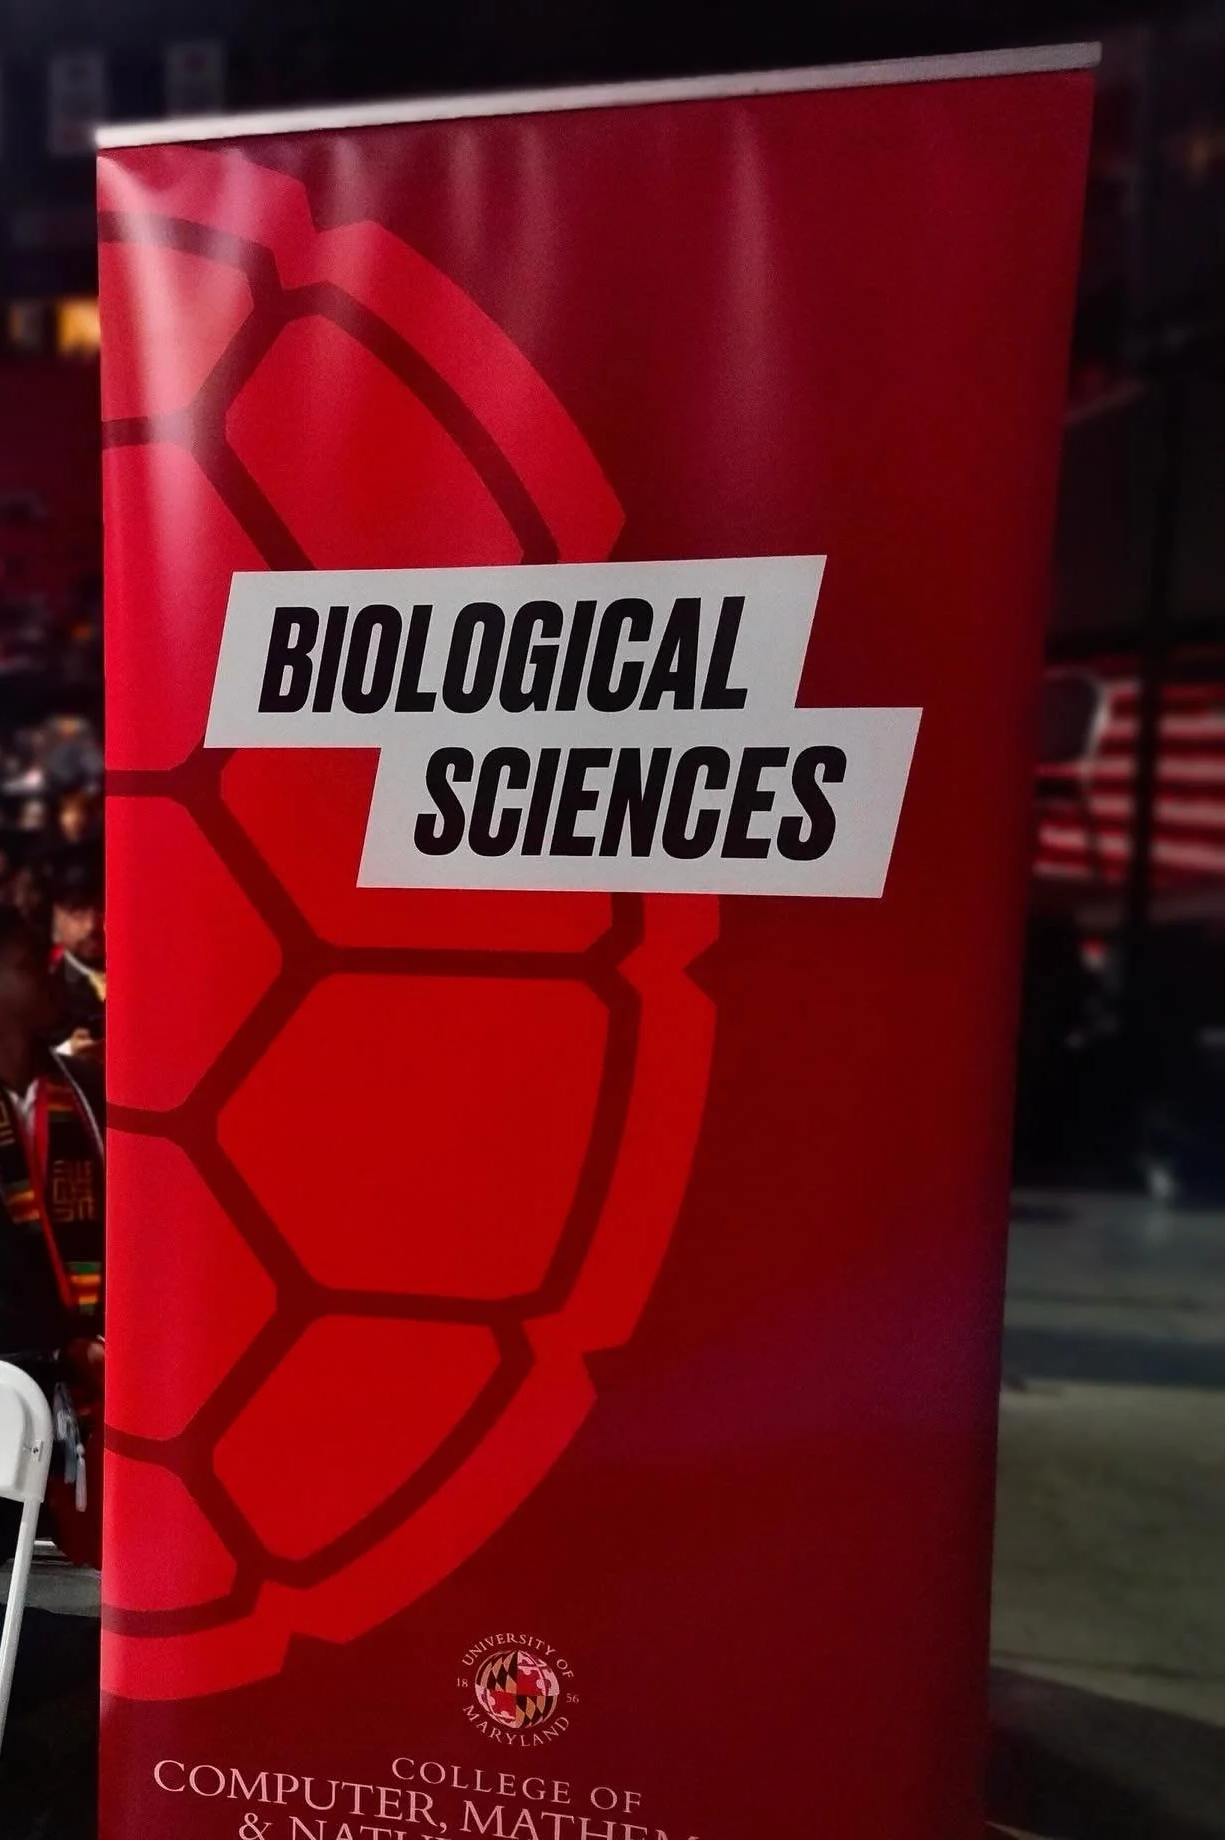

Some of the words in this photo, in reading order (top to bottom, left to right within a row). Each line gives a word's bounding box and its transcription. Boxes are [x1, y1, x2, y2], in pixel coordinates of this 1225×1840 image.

[257, 595, 748, 714] BIOLOGICAL
[414, 745, 847, 861] SCIENCES
[462, 1633, 556, 1666] UNIVERSITY
[556, 1659, 574, 1679] OF
[456, 1677, 469, 1688] 18
[566, 1693, 579, 1704] 56
[463, 1705, 570, 1747] MARYLAND
[153, 1759, 448, 1833] COMPUTER,
[391, 1757, 571, 1804] COLLEGE
[590, 1786, 641, 1813] OF
[238, 1812, 273, 1840] &
